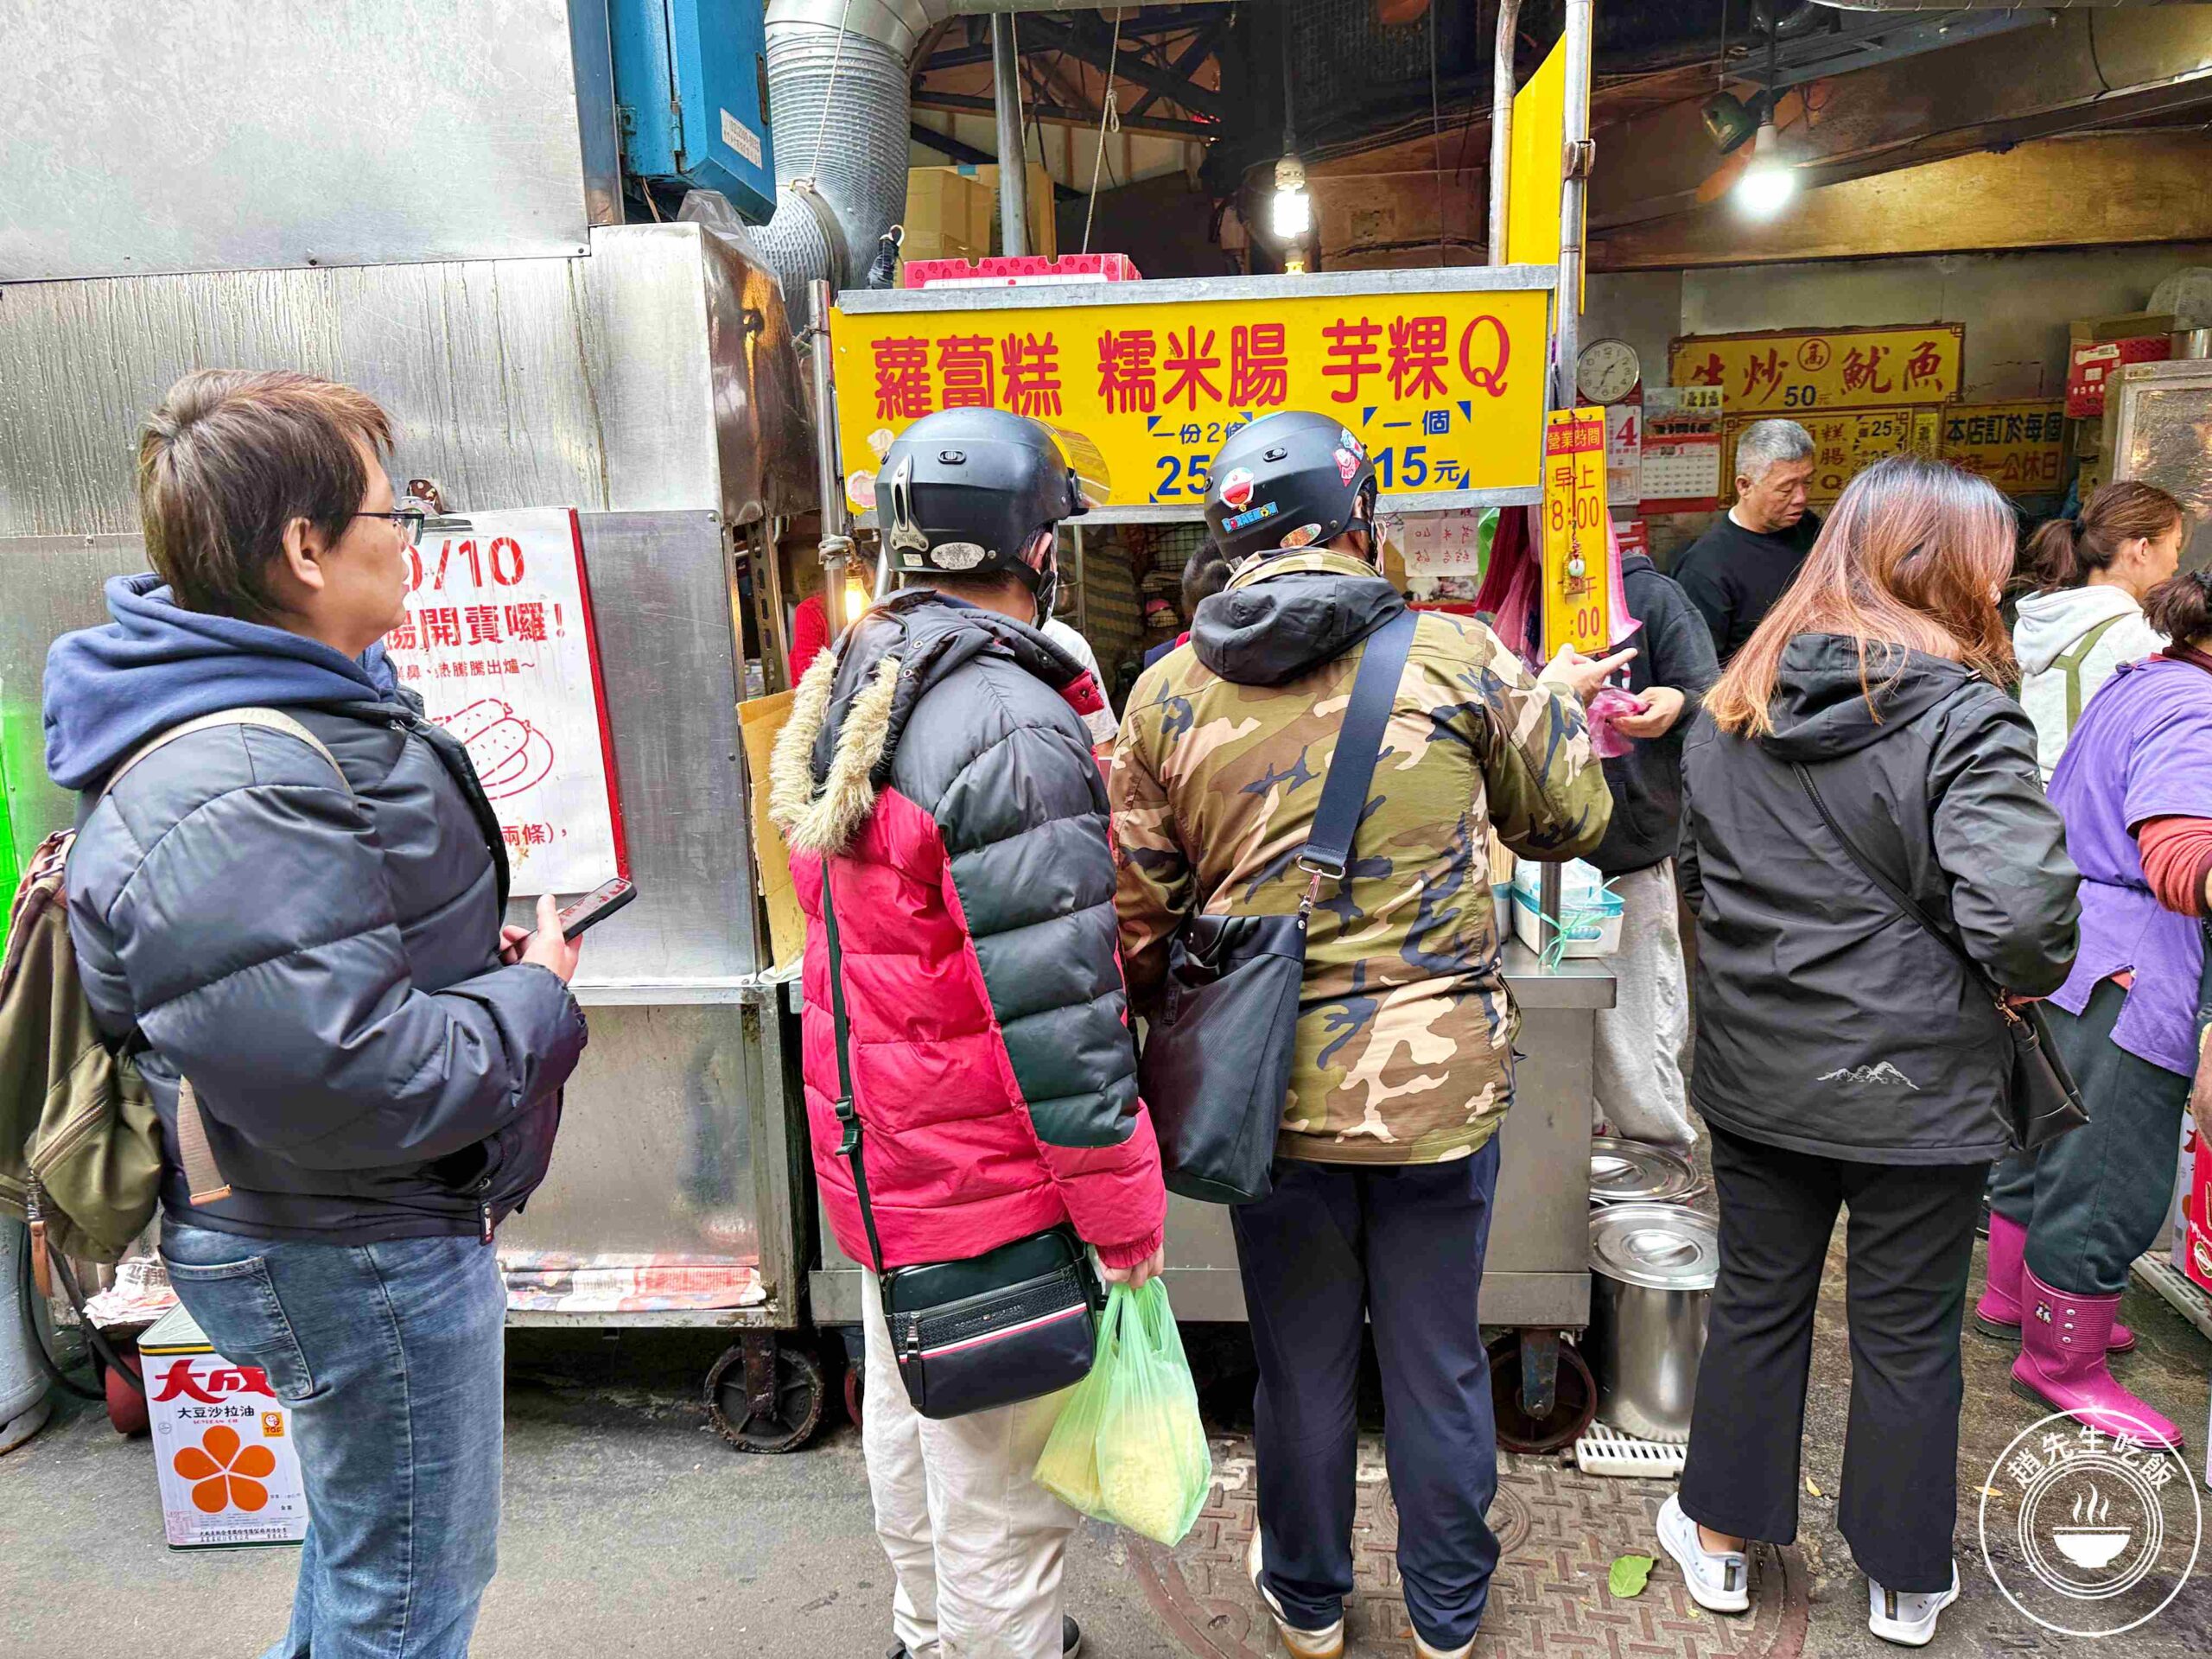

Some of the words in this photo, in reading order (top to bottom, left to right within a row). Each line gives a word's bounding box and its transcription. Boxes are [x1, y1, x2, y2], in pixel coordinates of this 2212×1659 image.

[871, 331, 1062, 421] 蘿蔔糕
[1097, 322, 1288, 414] 糯米腸
[1322, 315, 1510, 404] 芋粿Q
[1382, 410, 1450, 435] 一個
[1616, 416, 1637, 446] 4
[1547, 427, 1600, 450] 營業時間
[1554, 464, 1596, 493] 早上
[1949, 451, 2058, 480] 一公休日
[177, 1405, 255, 1419] 大豆沙拉油
